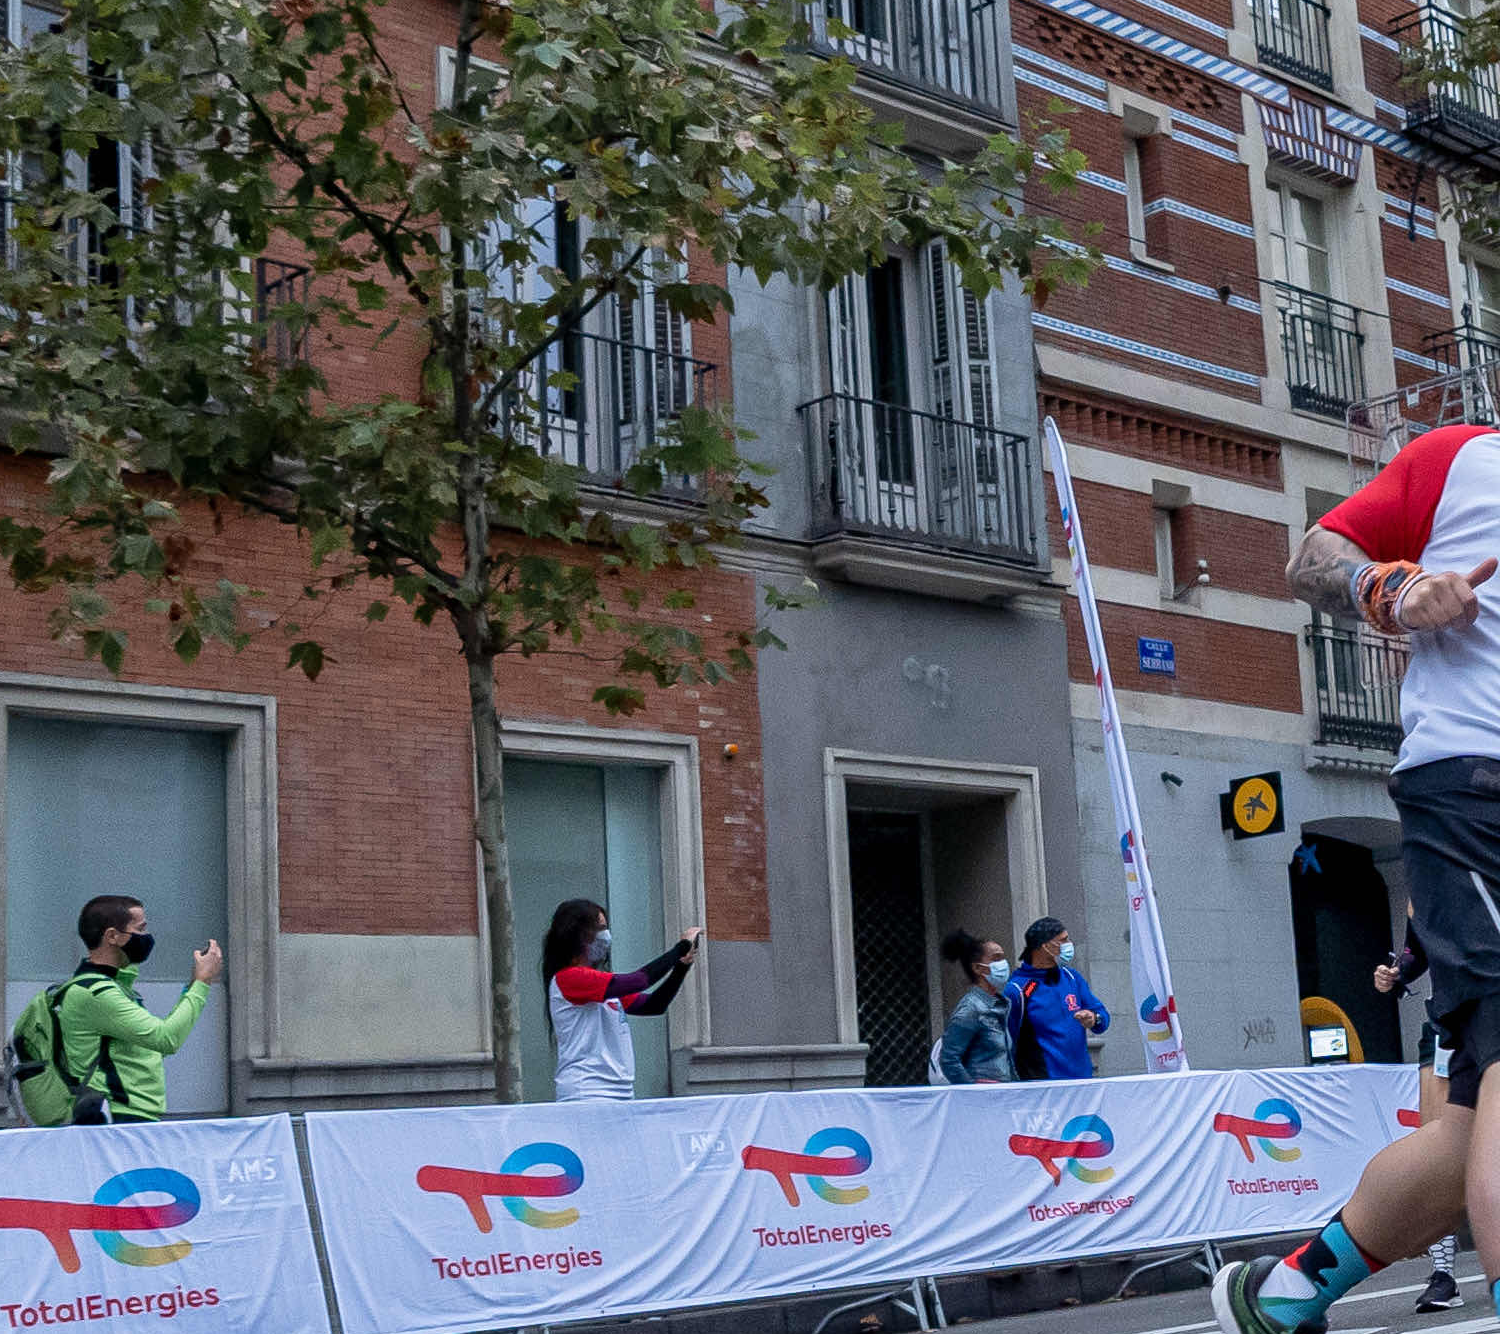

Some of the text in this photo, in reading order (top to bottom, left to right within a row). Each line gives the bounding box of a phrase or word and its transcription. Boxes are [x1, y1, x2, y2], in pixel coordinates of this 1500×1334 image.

[228, 1158, 278, 1182] AMS
[1227, 1176, 1319, 1196] TotalEnergies
[753, 1219, 892, 1248] TotalEnergies
[432, 1246, 603, 1280] TotalEnergies
[0, 1285, 220, 1328] TotalEnergies
